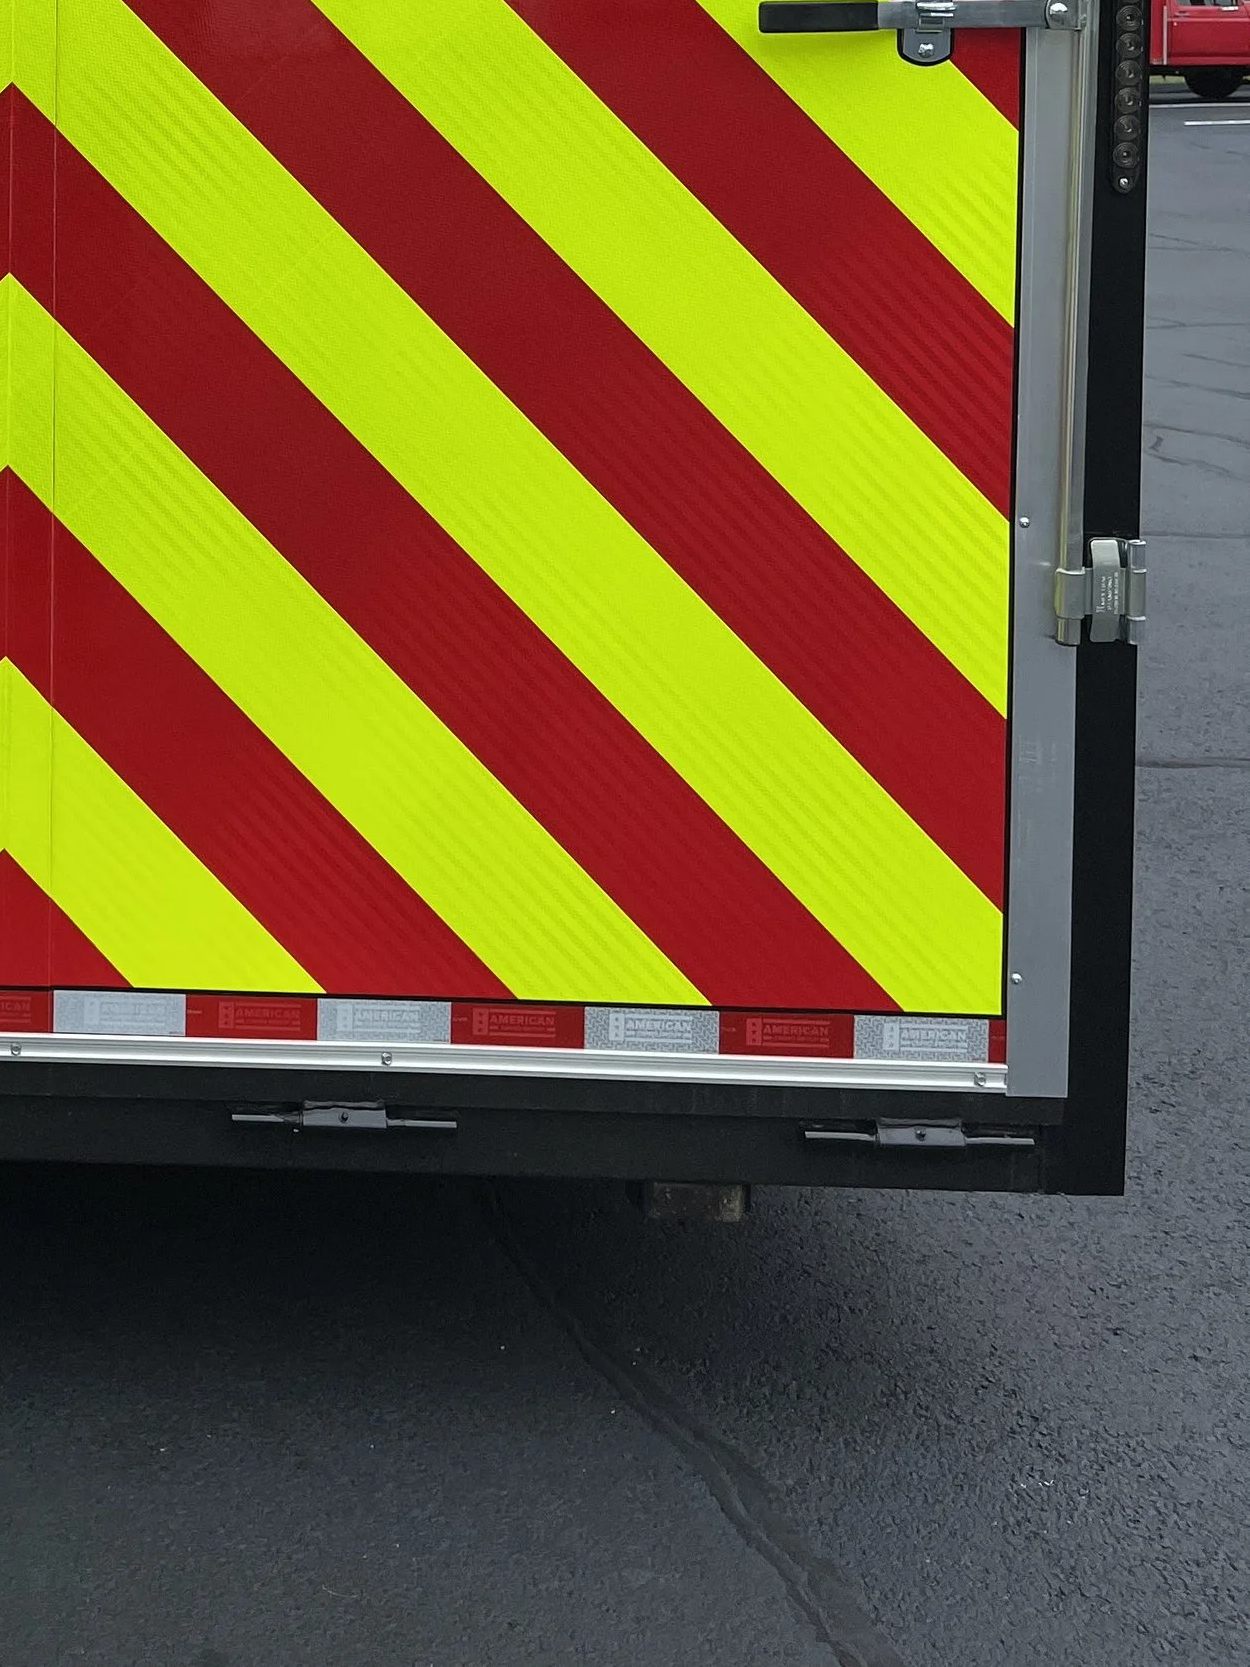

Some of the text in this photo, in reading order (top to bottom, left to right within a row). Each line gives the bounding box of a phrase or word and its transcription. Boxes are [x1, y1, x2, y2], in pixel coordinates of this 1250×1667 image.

[490, 1015, 555, 1025] AMERICAN
[626, 1020, 692, 1030] AMERICAN
[763, 1024, 829, 1035] AMERICAN
[901, 1030, 966, 1041] AMERICAN
